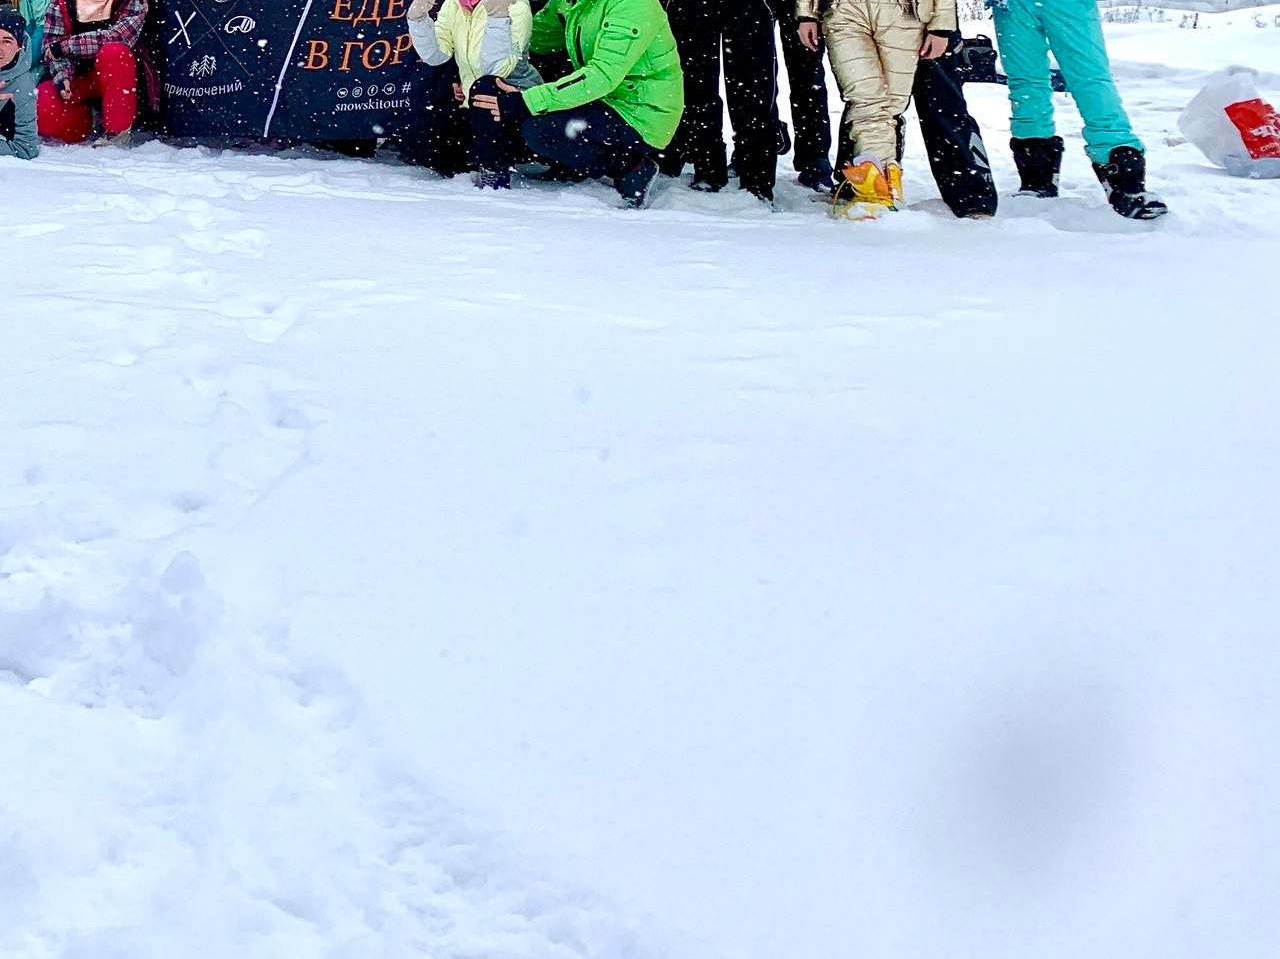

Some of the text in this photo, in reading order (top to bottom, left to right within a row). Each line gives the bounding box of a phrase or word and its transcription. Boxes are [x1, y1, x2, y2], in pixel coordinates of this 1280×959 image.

[304, 33, 424, 71] В ГОР
[164, 79, 243, 98] приключений
[335, 98, 411, 112] snowskitours
